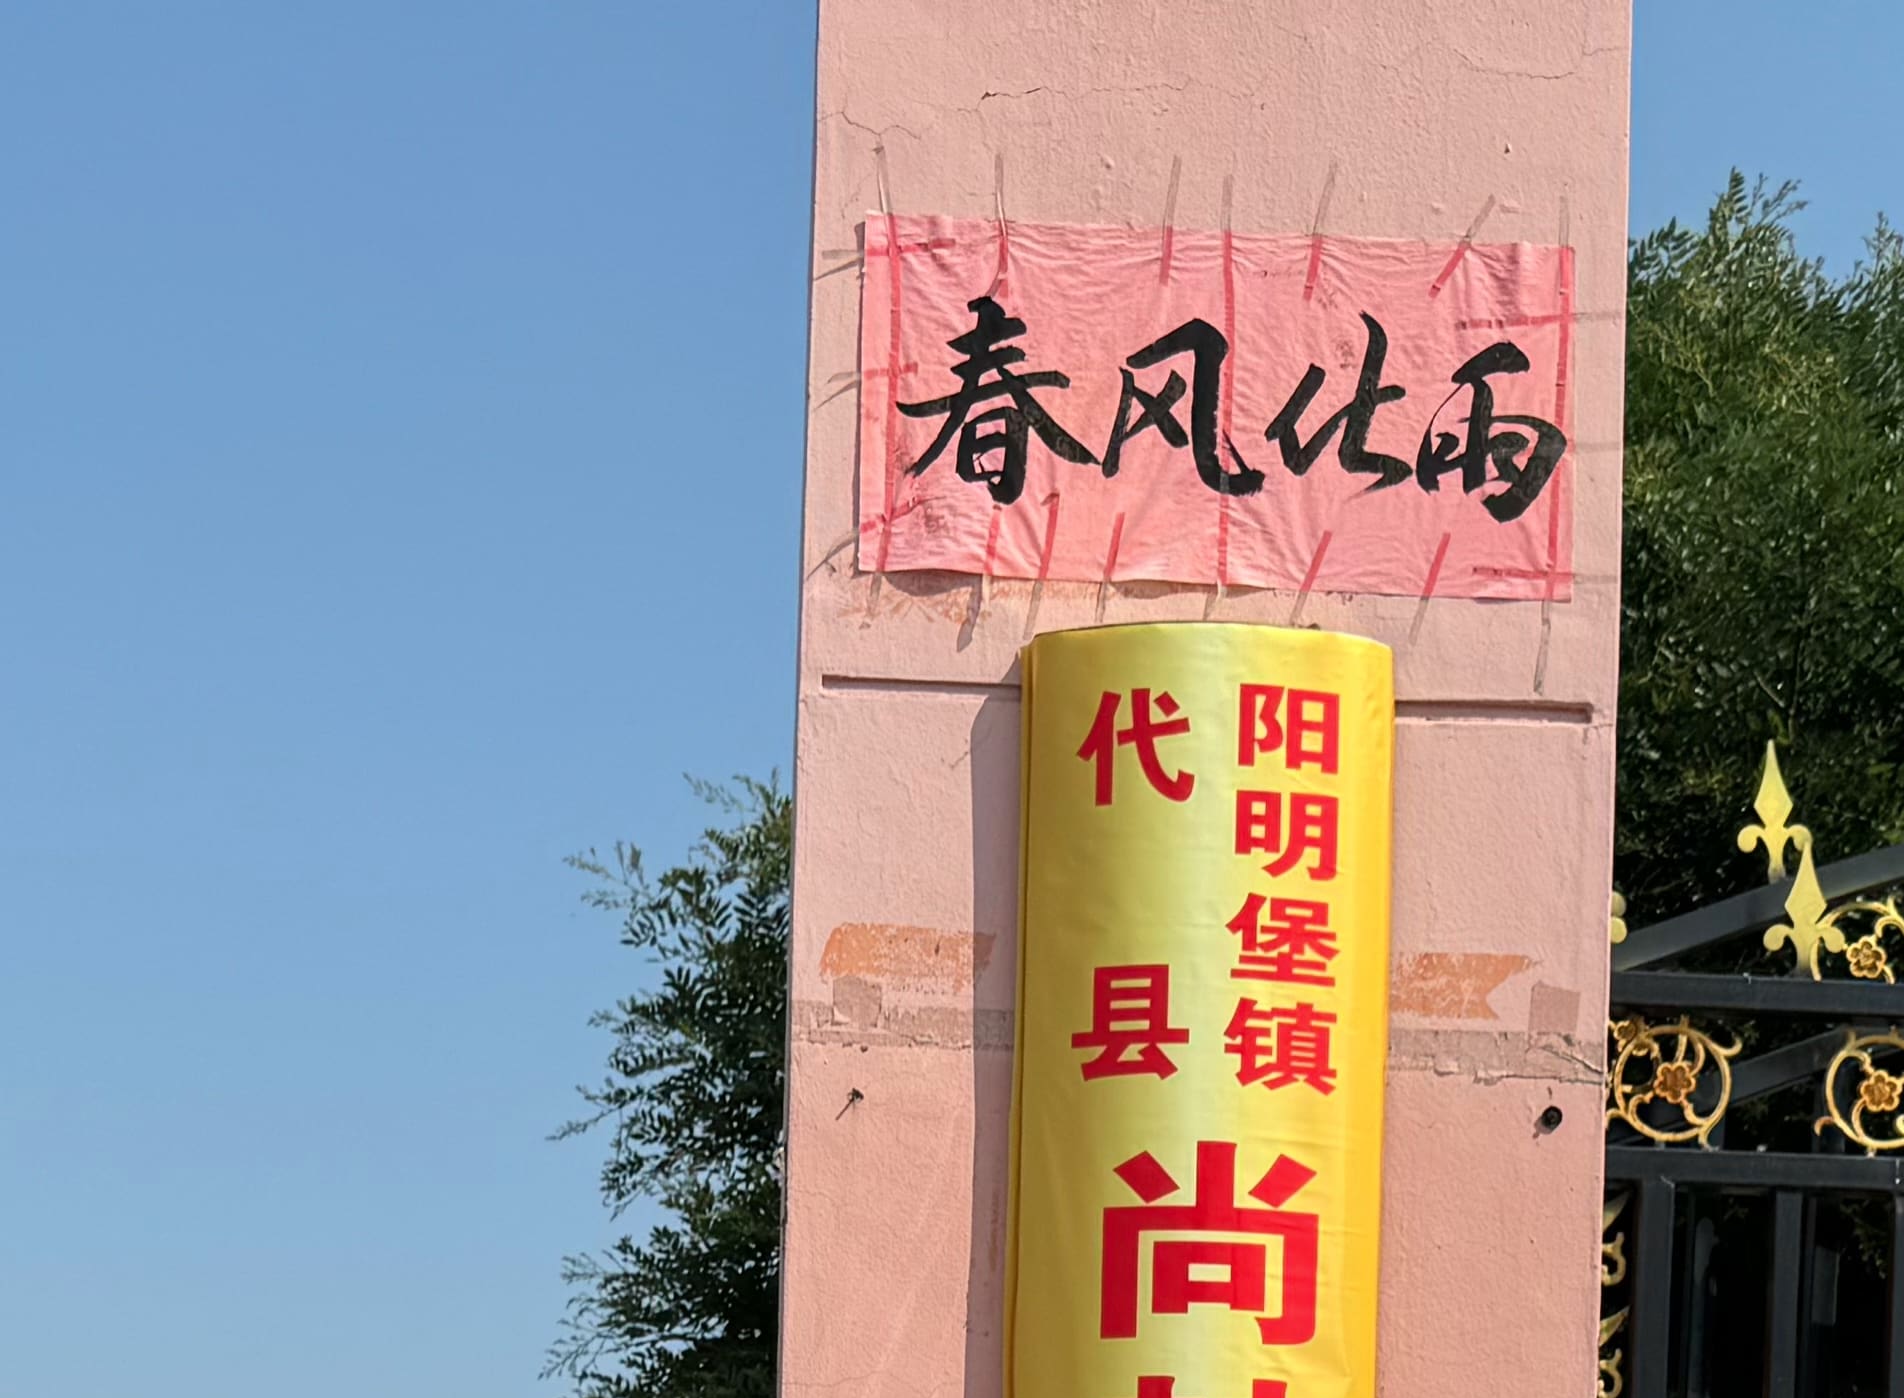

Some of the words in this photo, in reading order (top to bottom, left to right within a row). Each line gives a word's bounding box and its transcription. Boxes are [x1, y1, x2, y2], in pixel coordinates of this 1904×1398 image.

[895, 295, 1568, 524] 春风化雨
[1072, 688, 1194, 1082] 代县
[1224, 683, 1339, 1095] 阳明堡镇
